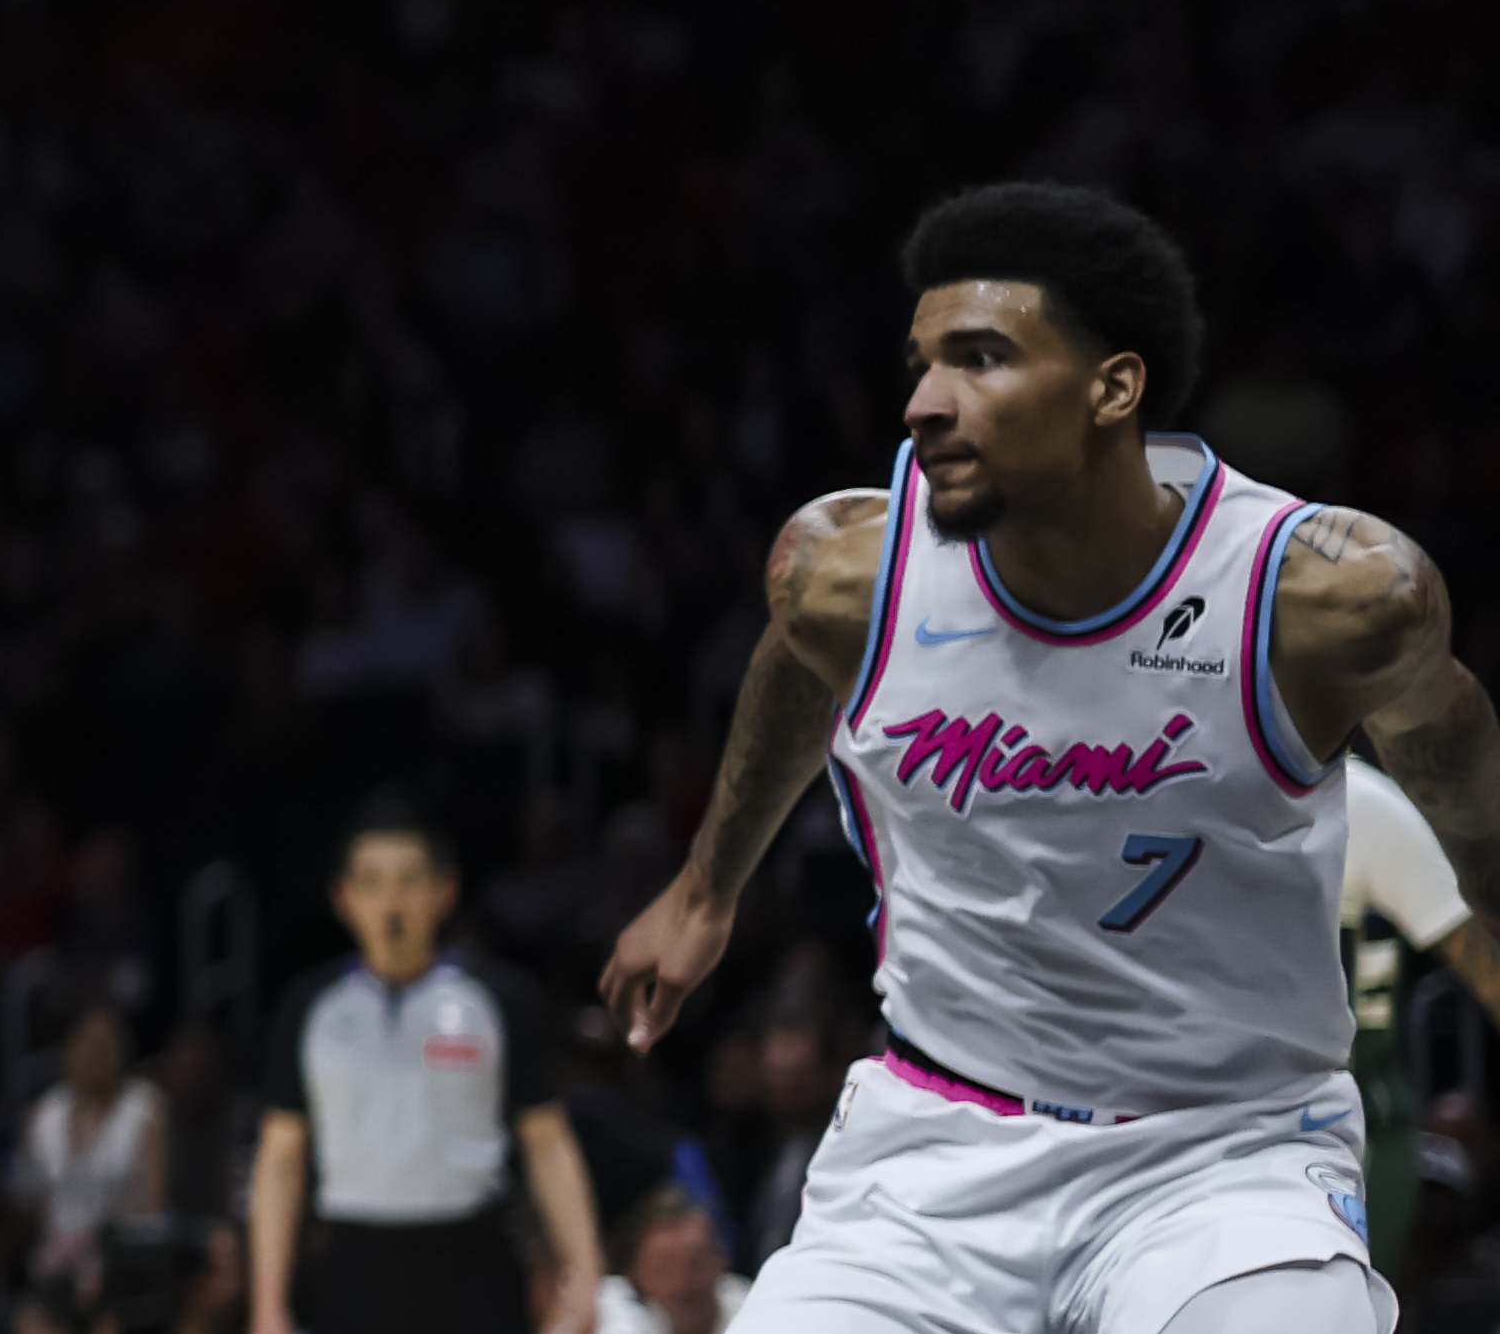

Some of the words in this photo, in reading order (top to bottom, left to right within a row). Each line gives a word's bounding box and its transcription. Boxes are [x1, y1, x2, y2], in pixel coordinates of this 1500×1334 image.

[1130, 651, 1225, 675] Robinhood
[882, 707, 1208, 813] Miami
[1097, 832, 1203, 936] 7
